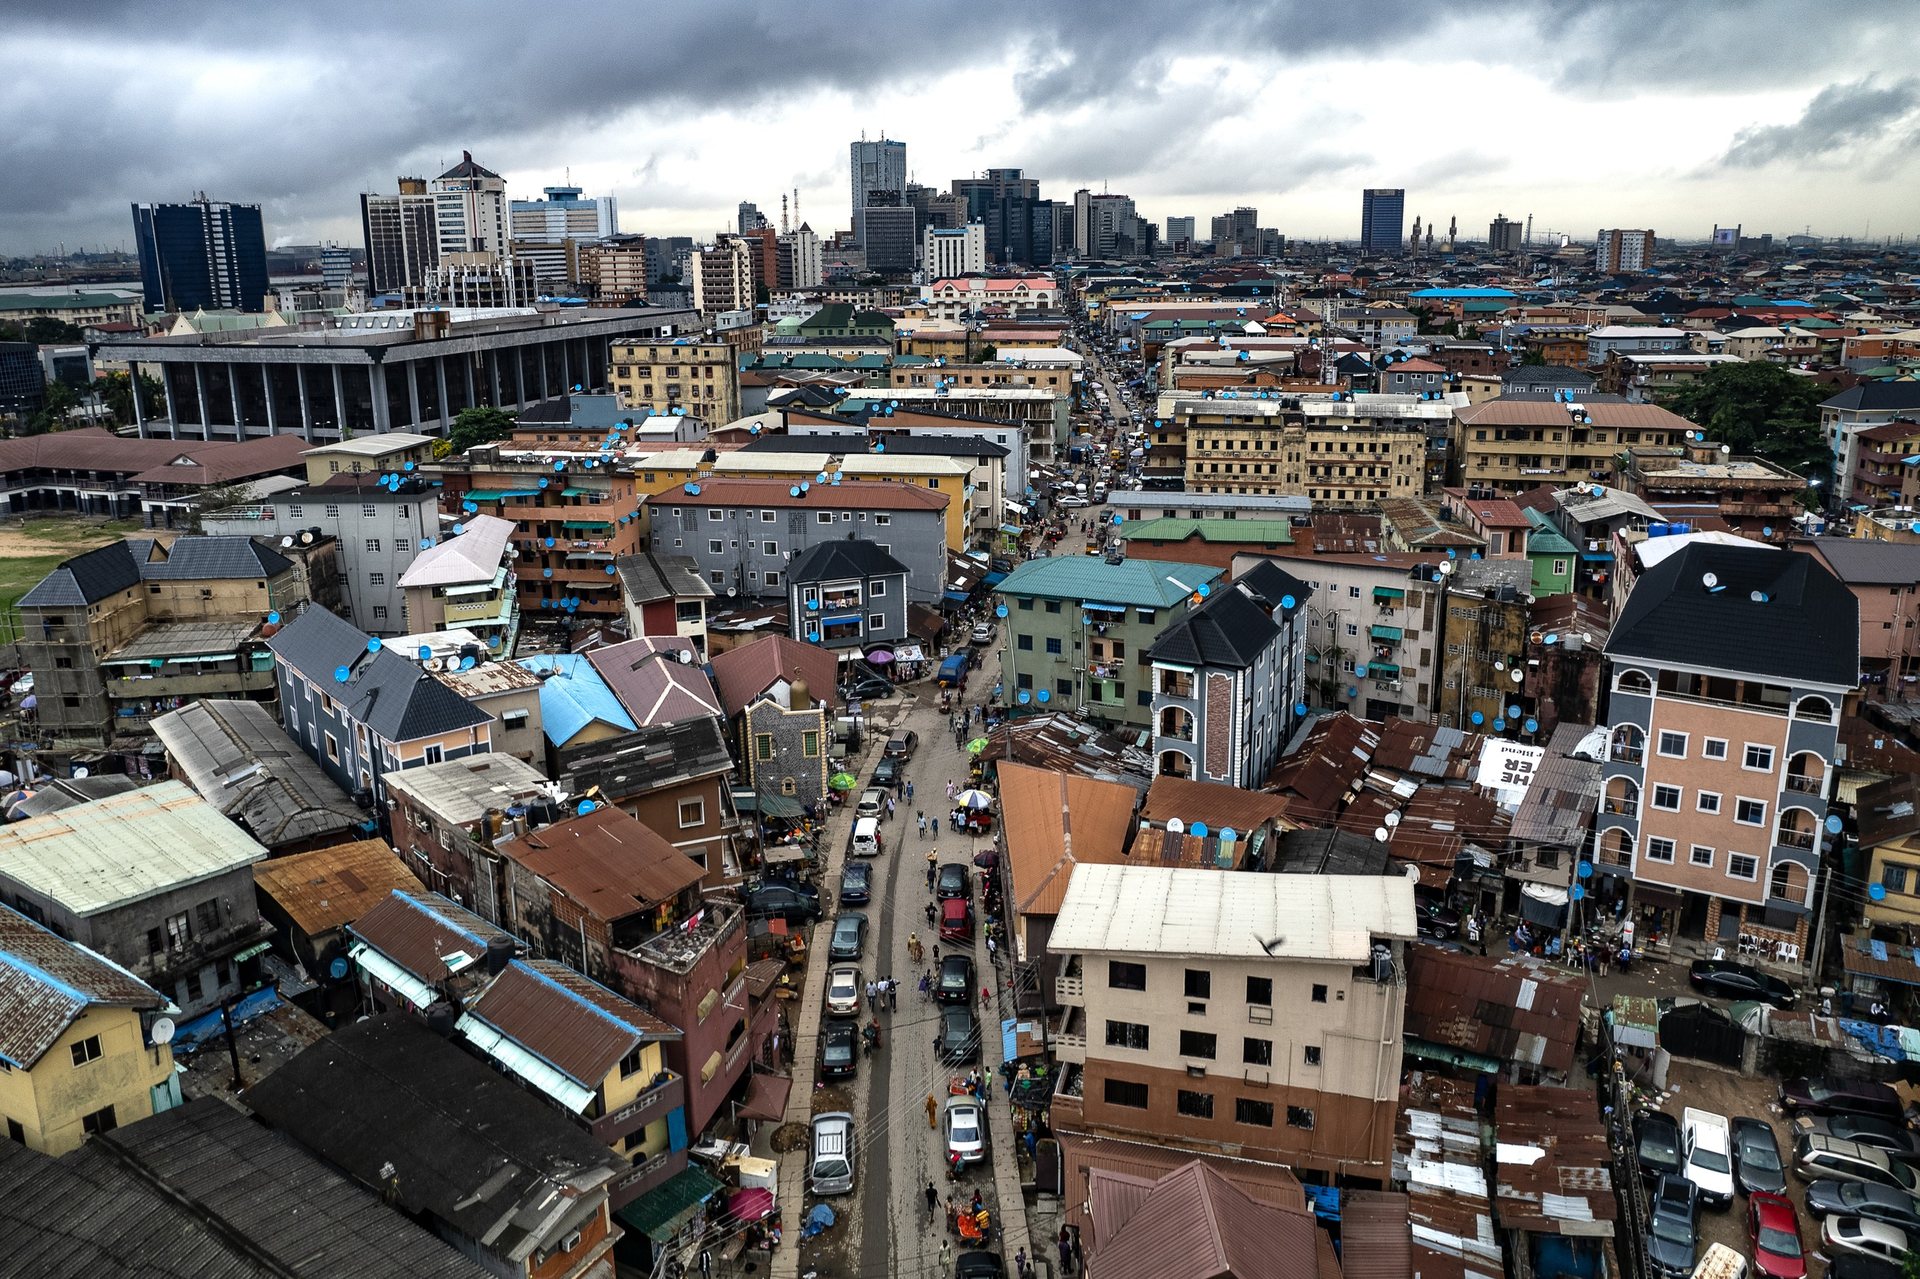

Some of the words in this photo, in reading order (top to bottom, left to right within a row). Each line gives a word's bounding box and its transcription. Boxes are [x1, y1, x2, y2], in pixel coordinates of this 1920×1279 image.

[1501, 747, 1534, 757] Blend
[1504, 759, 1535, 773] ER
[1501, 772, 1530, 786] HE
